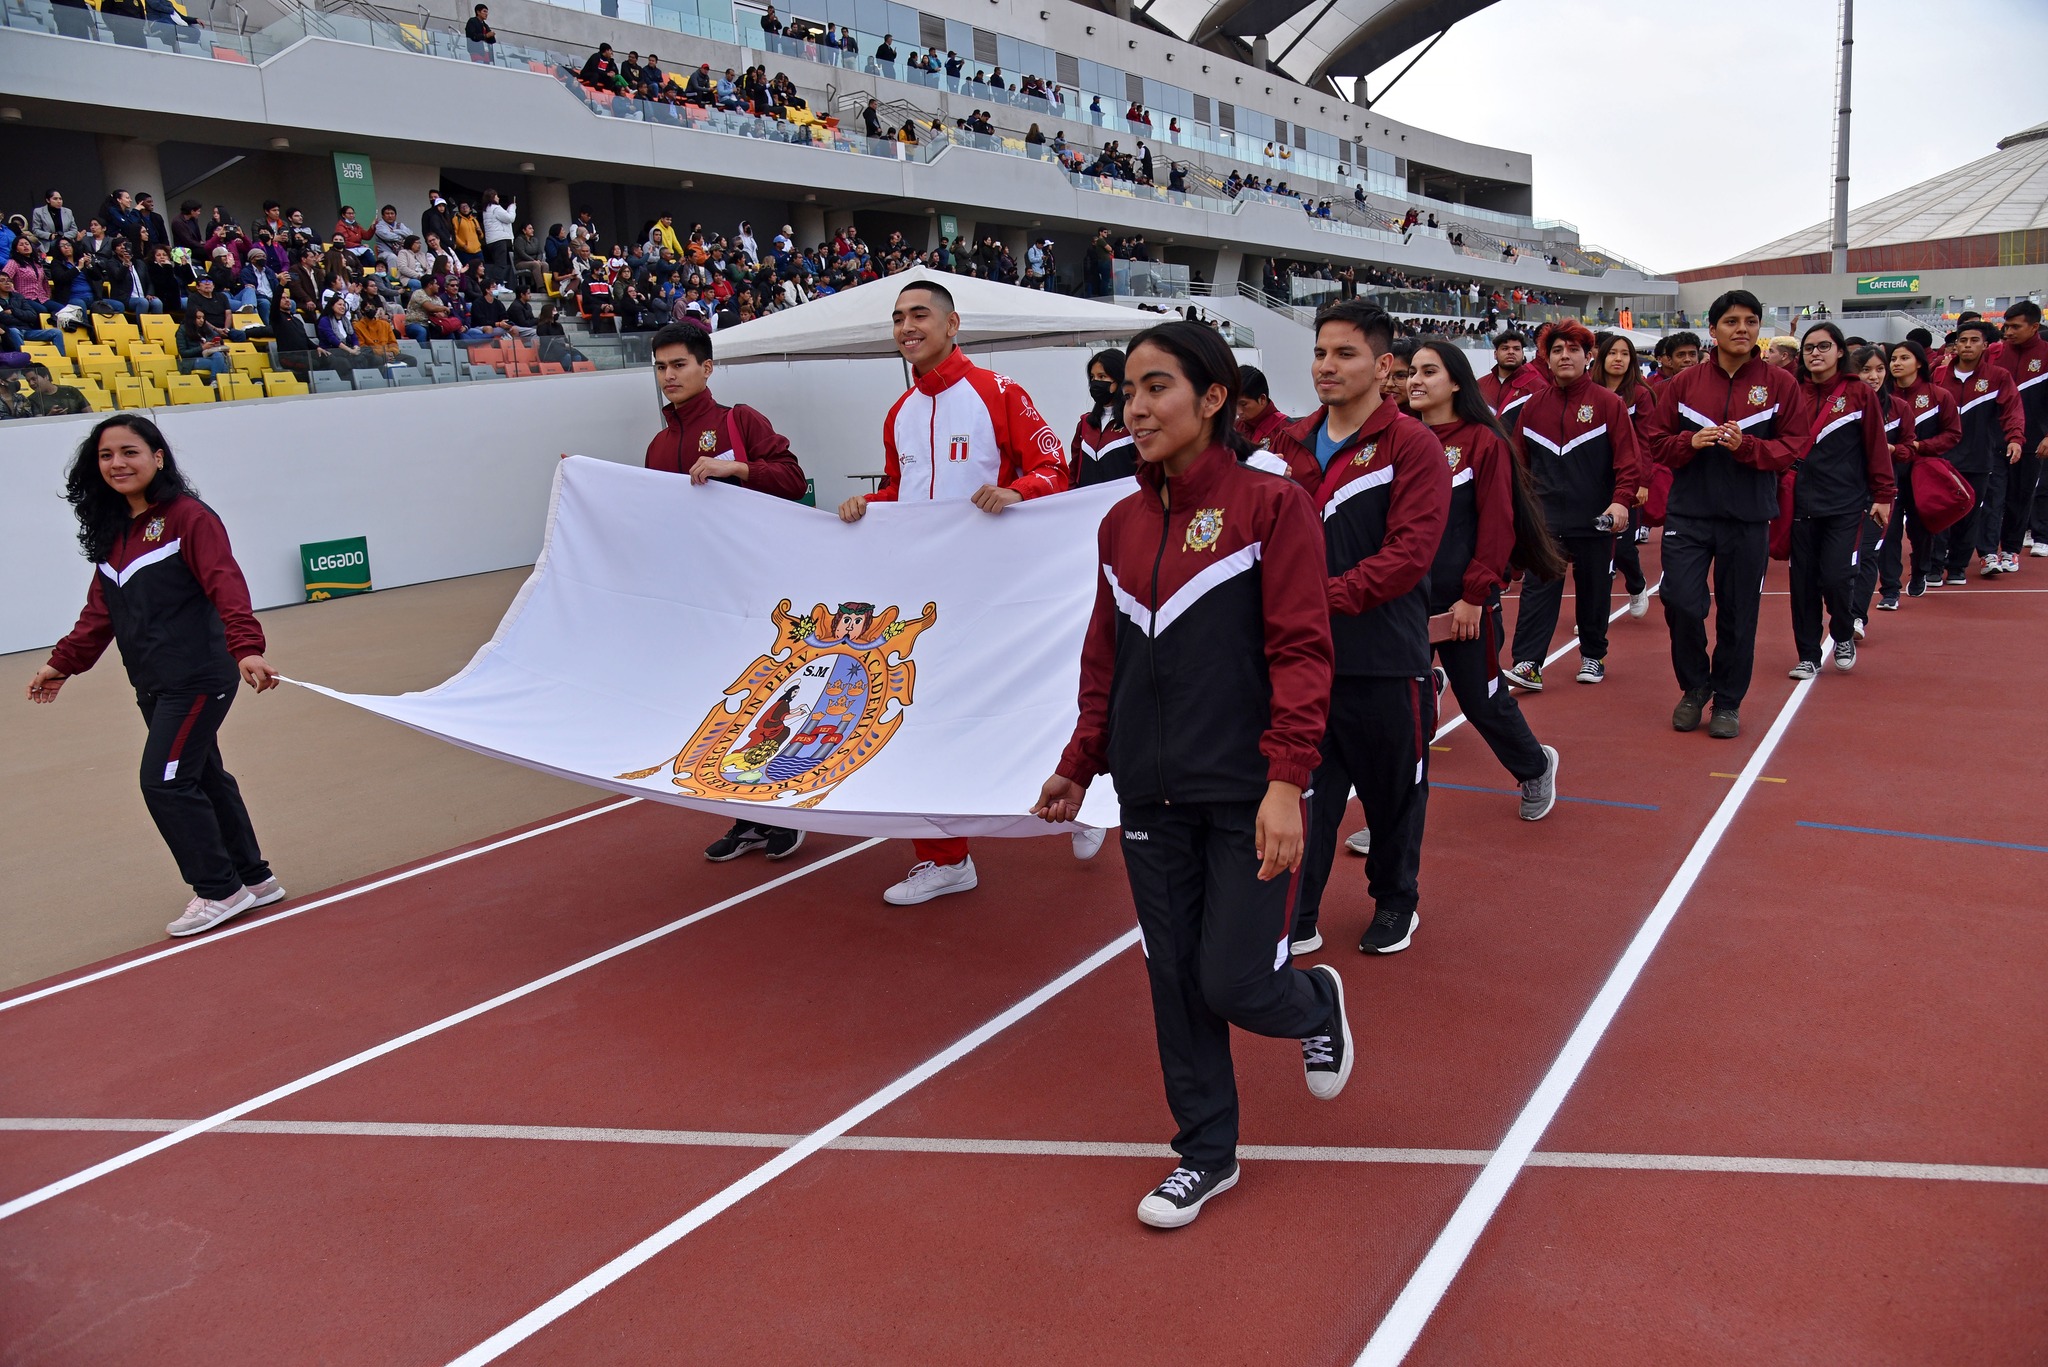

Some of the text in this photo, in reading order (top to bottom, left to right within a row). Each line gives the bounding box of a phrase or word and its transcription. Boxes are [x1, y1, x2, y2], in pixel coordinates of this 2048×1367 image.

[344, 170, 363, 179] 2019
[1870, 279, 1908, 289] CAFETERÍA
[743, 697, 764, 716] IN
[858, 650, 884, 741] ACADEMIA
[701, 722, 745, 769] REGVM
[749, 764, 829, 793] MARCI
